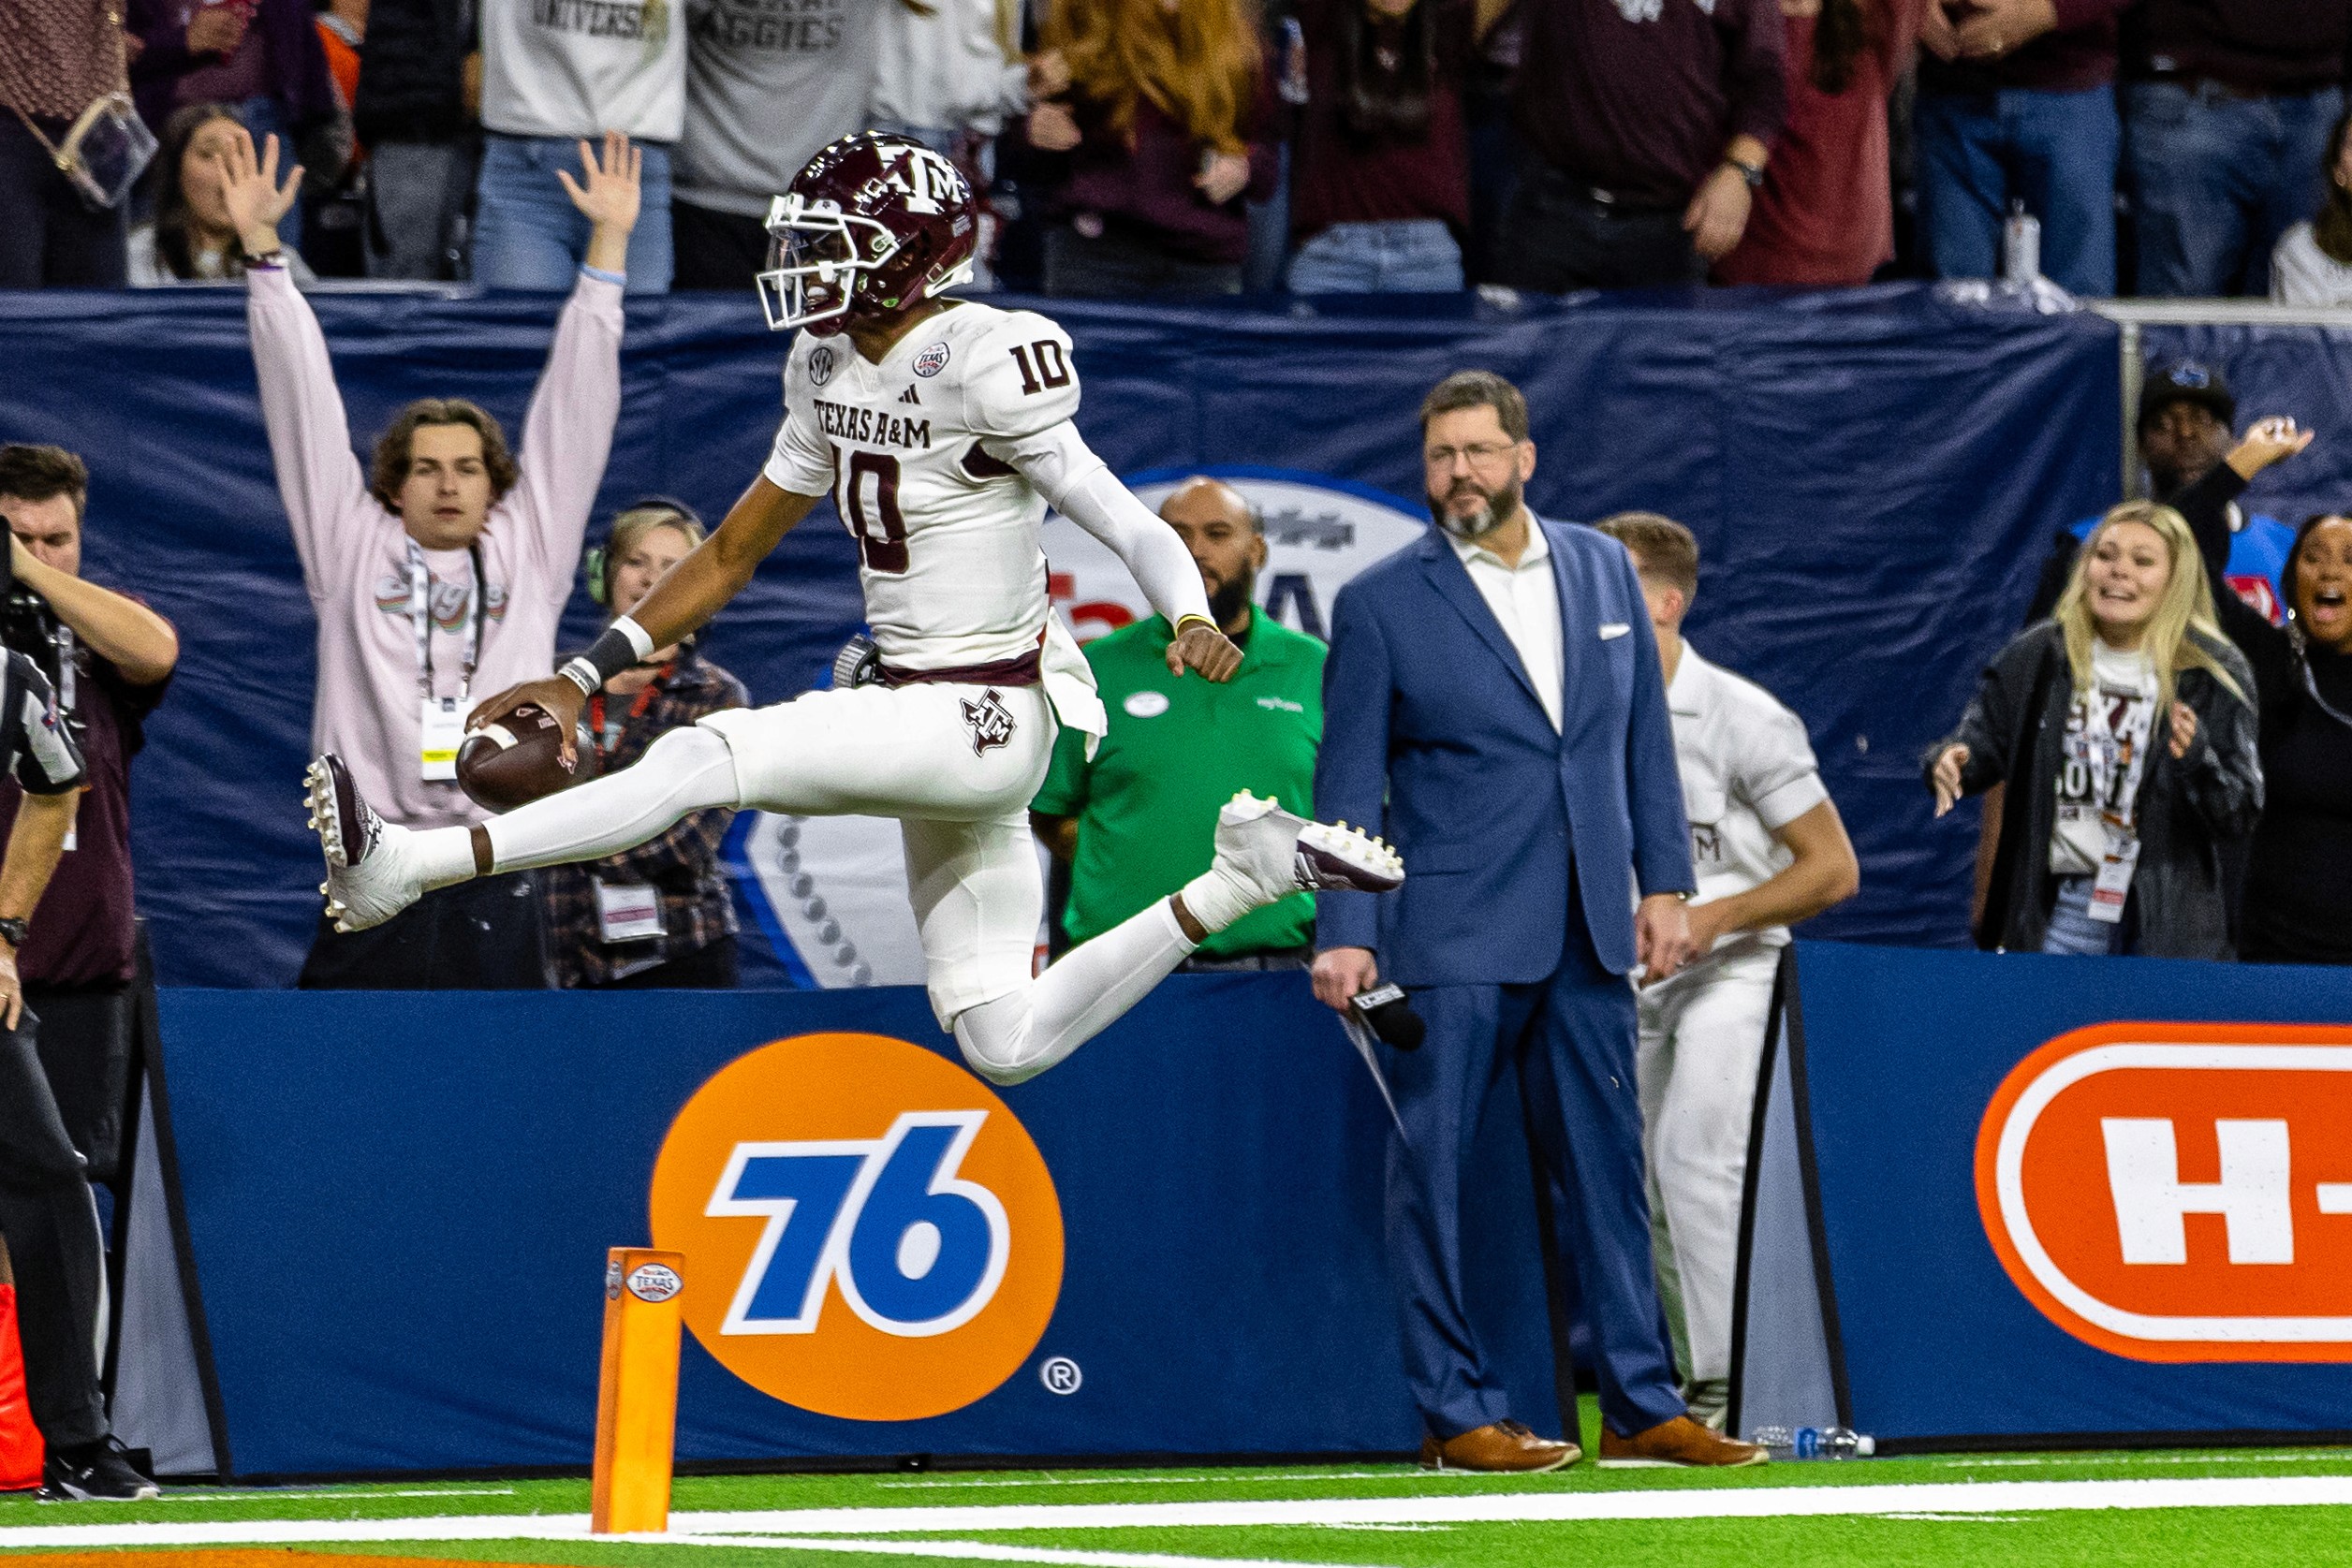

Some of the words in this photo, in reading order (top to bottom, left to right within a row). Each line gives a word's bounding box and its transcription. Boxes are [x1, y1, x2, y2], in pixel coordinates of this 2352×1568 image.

[1008, 340, 1071, 395] 10
[814, 399, 873, 443] TEXAS
[873, 412, 932, 449] A&M
[703, 1109, 1011, 1338] 76
